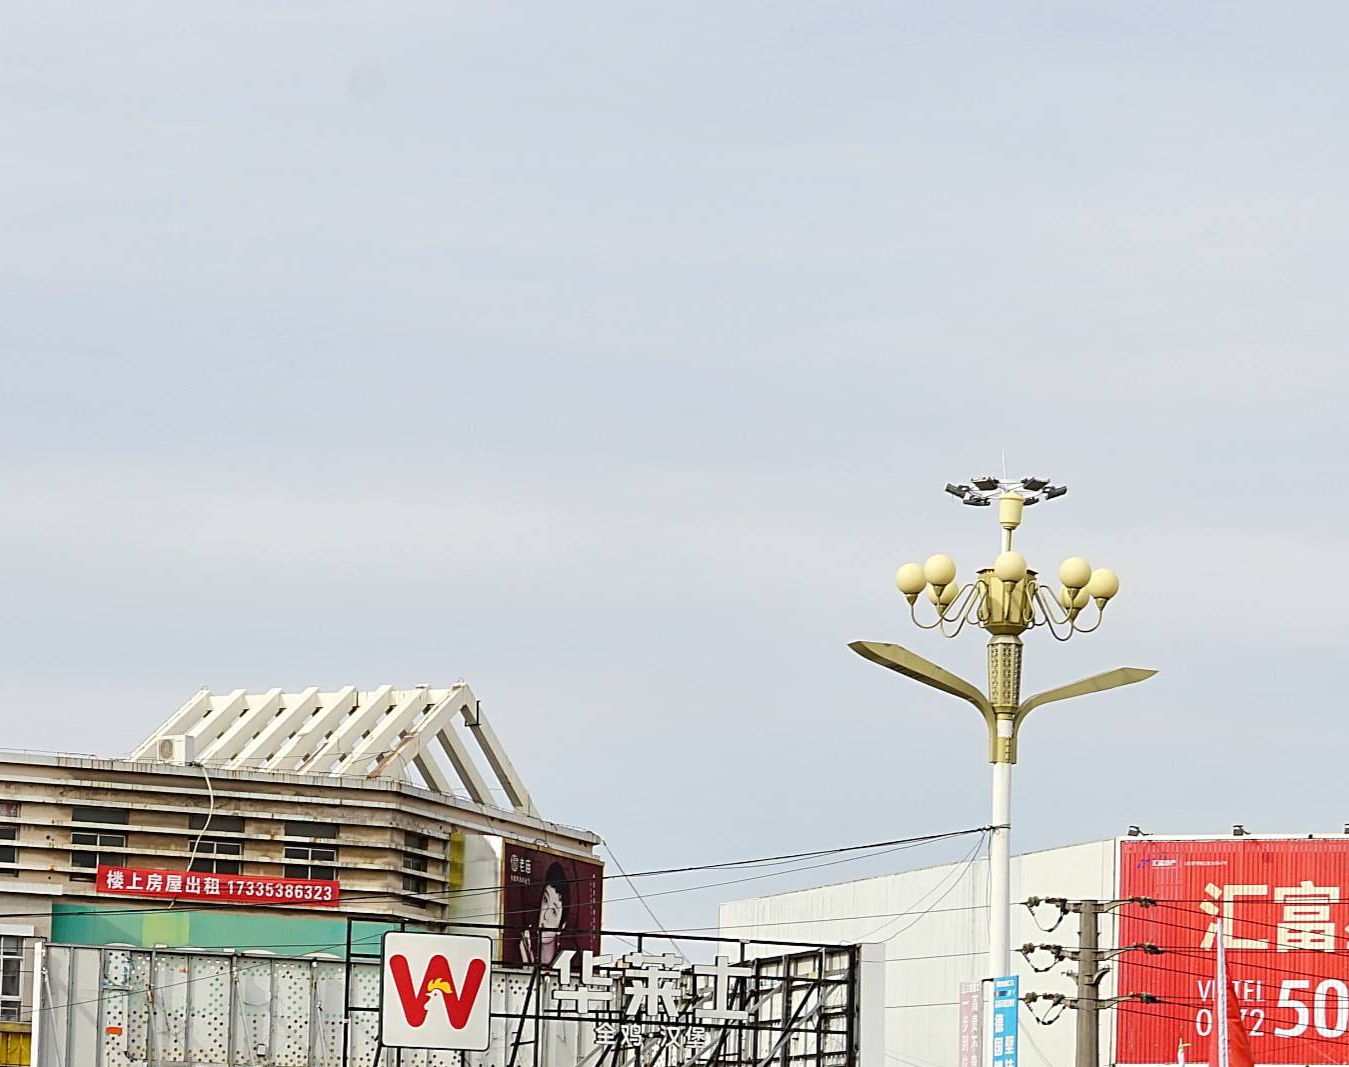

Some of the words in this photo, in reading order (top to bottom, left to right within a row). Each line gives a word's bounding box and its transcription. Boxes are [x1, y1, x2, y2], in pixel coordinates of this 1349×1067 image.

[107, 869, 220, 896] 楼上房屋出租
[227, 880, 333, 901] 17335386323
[553, 950, 753, 1020] 华莱士
[594, 1023, 707, 1050] 全鸡·汉堡
[1195, 1008, 1265, 1037] 02
